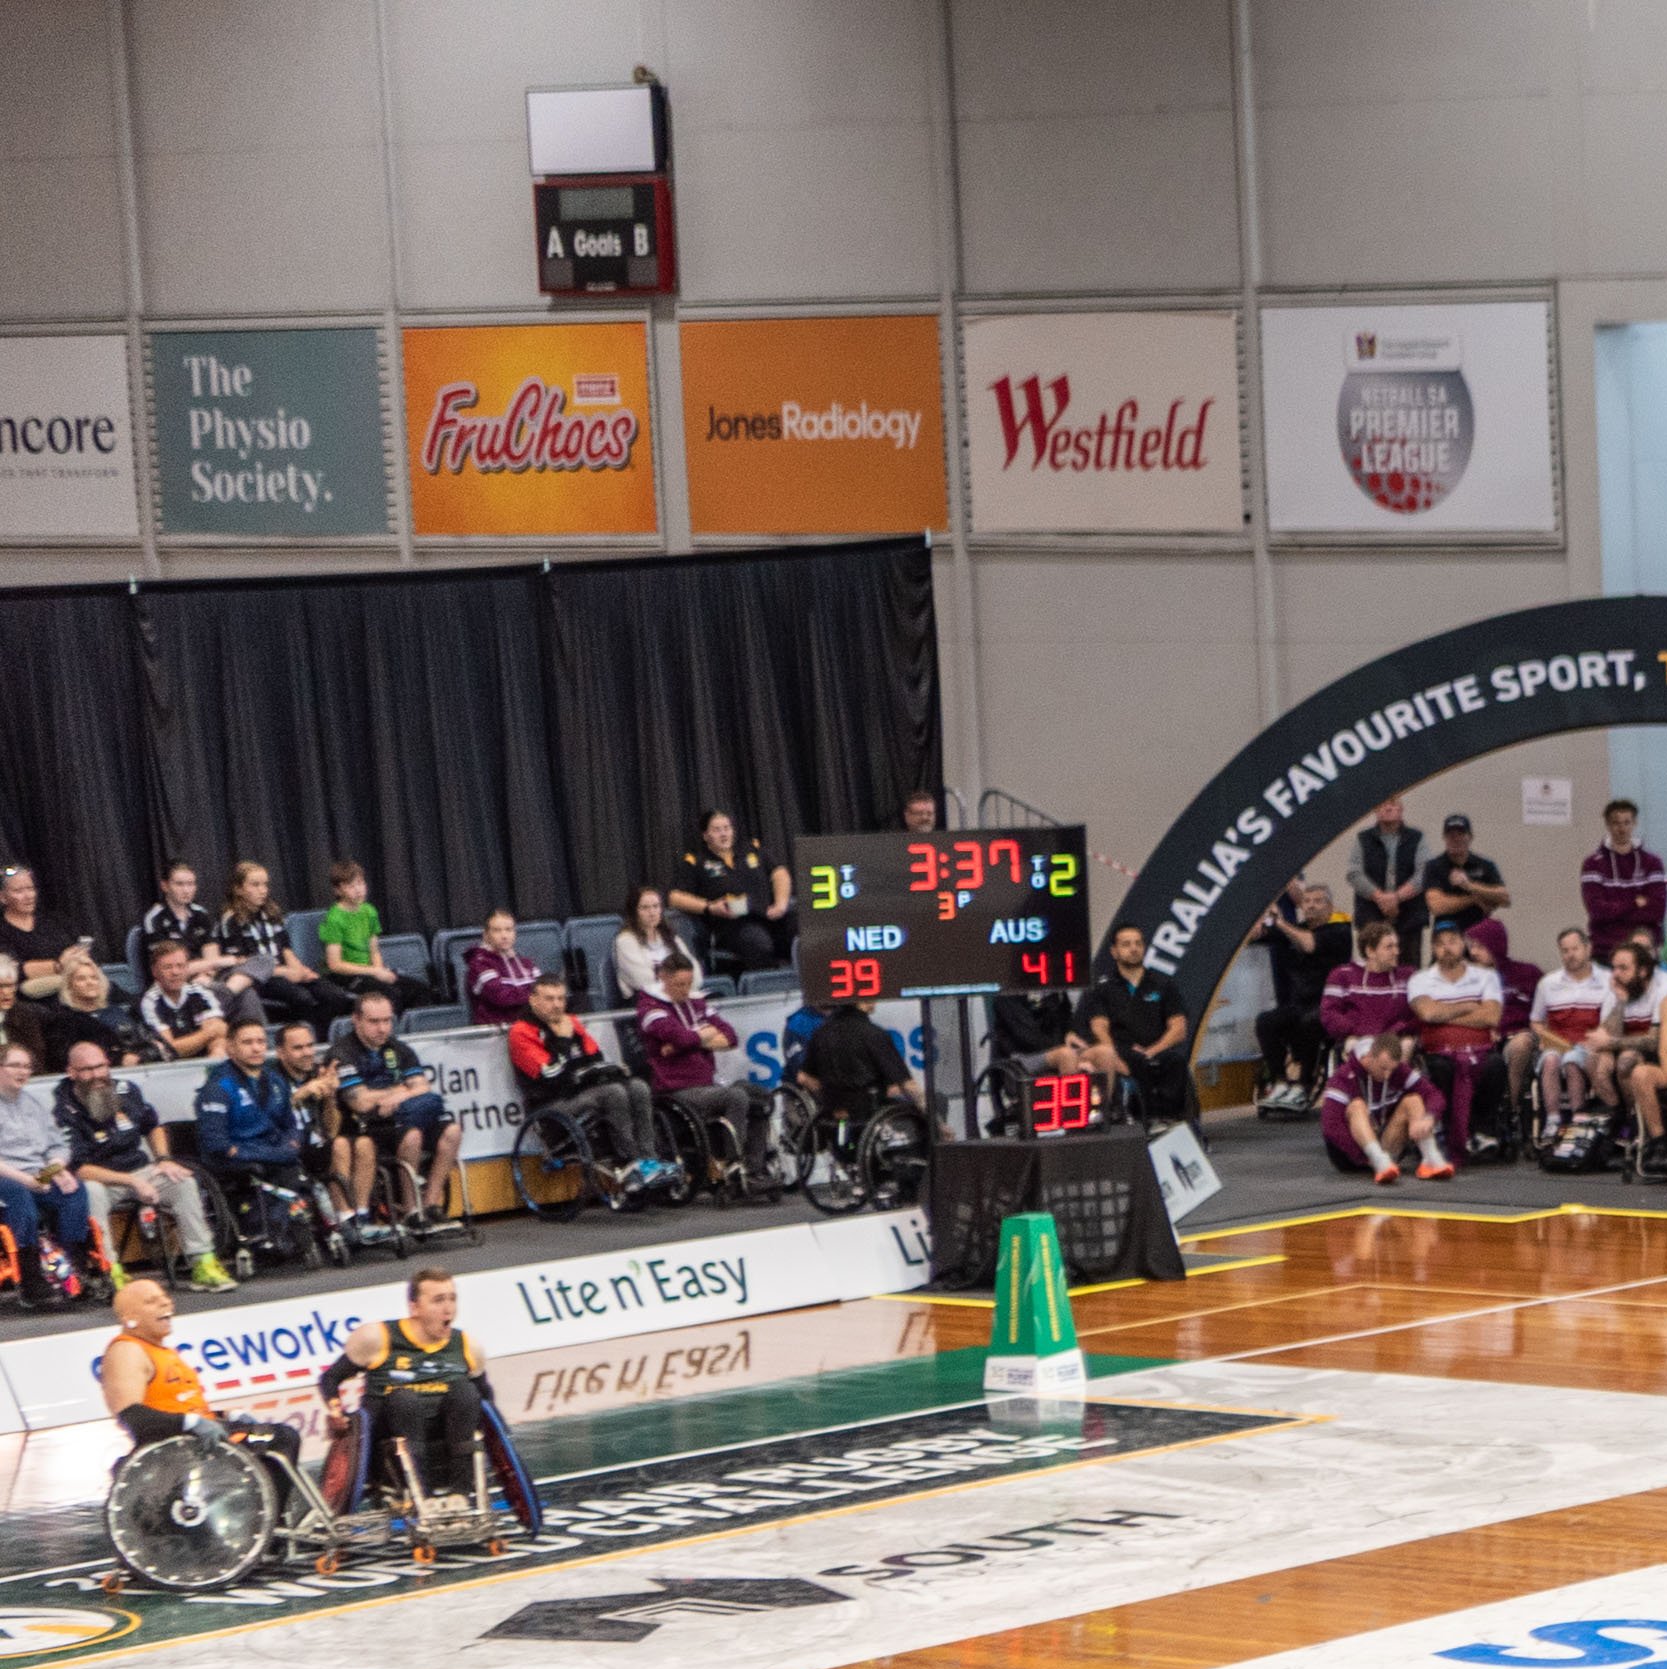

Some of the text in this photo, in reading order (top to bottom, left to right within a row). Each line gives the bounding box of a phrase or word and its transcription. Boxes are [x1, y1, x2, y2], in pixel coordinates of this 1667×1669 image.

[546, 223, 649, 259] A Goals B
[184, 354, 252, 399] The
[190, 408, 312, 459] Physio
[424, 379, 634, 470] FruChocs
[987, 373, 1214, 473] Westfield
[1350, 408, 1459, 438] PREMIER
[1361, 442, 1450, 474] LEAGUE
[190, 461, 334, 513] Society.
[1141, 806, 1273, 977] TRALIA'S
[1265, 673, 1487, 821] FAVOURITE
[1490, 648, 1646, 705] SPORT,
[810, 865, 838, 910] 3
[907, 838, 1022, 892] 3:37
[1049, 853, 1078, 898] 2
[938, 891, 956, 920] 3
[846, 918, 1046, 952] NED AUS
[829, 951, 1076, 999] 39 41
[1033, 1073, 1090, 1133] 39
[517, 1273, 608, 1327] Lite
[646, 1257, 749, 1304] Easy
[721, 1427, 1022, 1487] RUGBY
[580, 1434, 1119, 1537] CHALLENGE
[818, 1507, 1184, 1583] SOUTH
